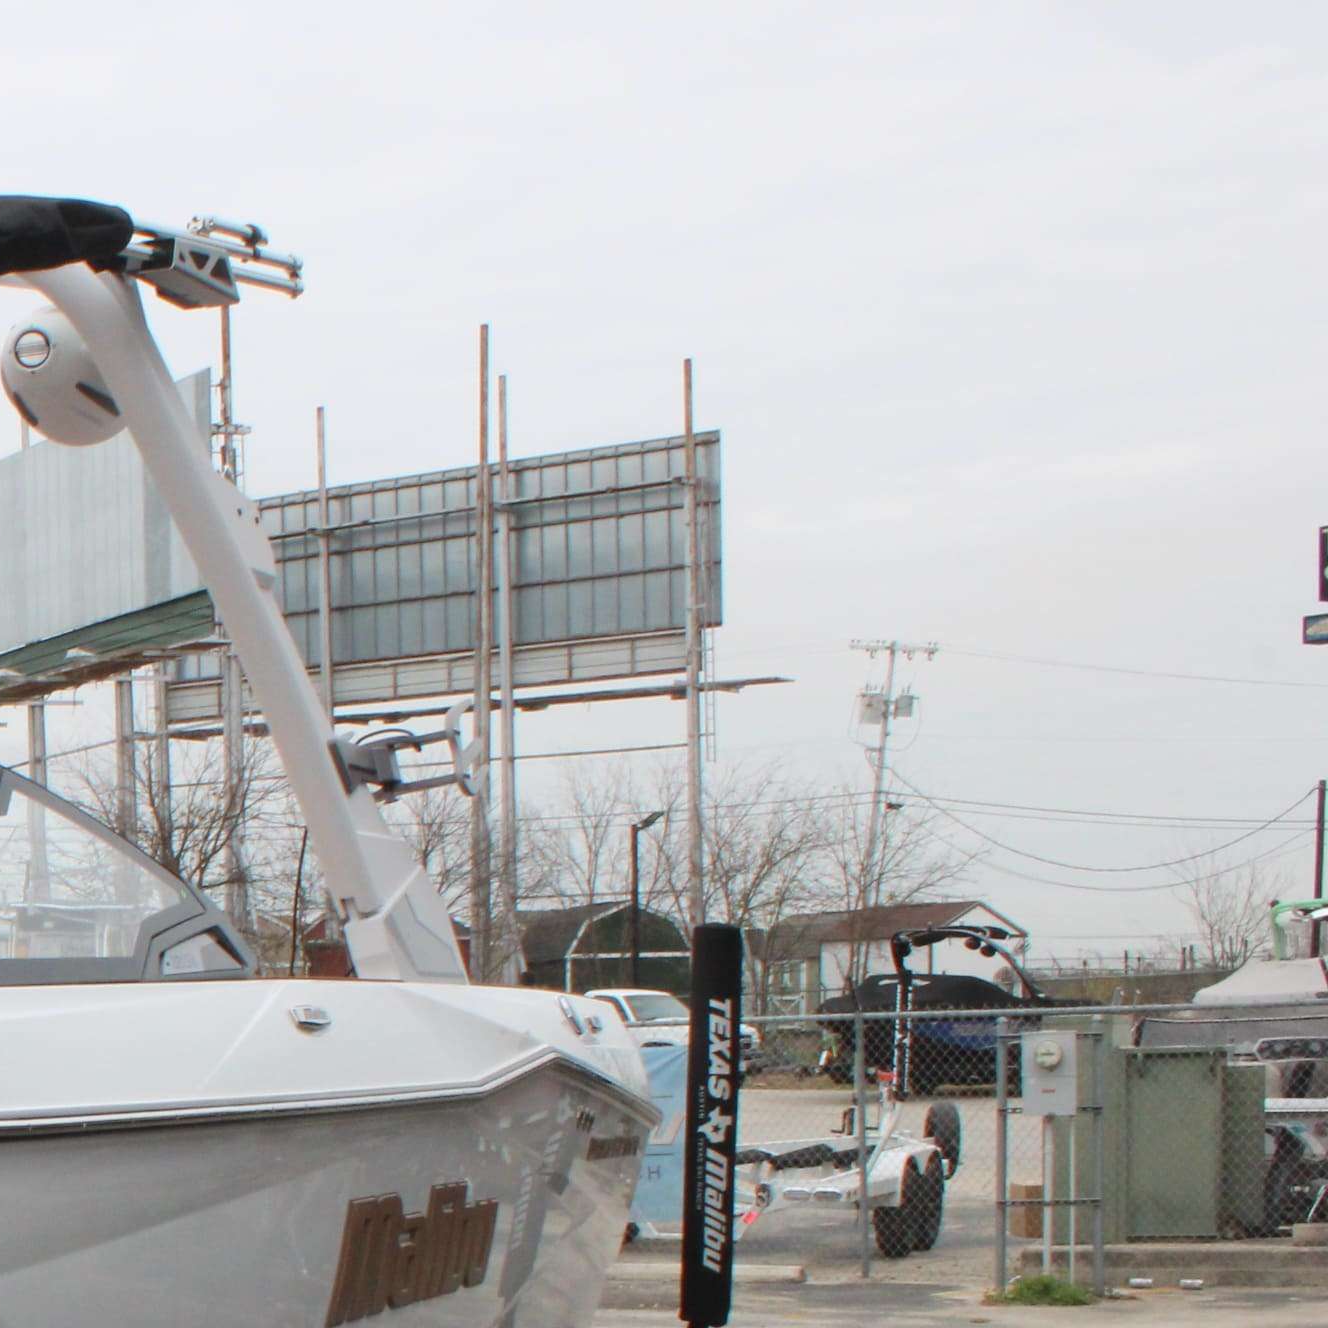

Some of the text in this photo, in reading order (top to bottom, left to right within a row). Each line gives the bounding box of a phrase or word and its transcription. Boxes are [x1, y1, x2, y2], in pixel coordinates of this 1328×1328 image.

[696, 1137, 705, 1164] TEXAS
[703, 998, 733, 1274] TEXAS Malibu
